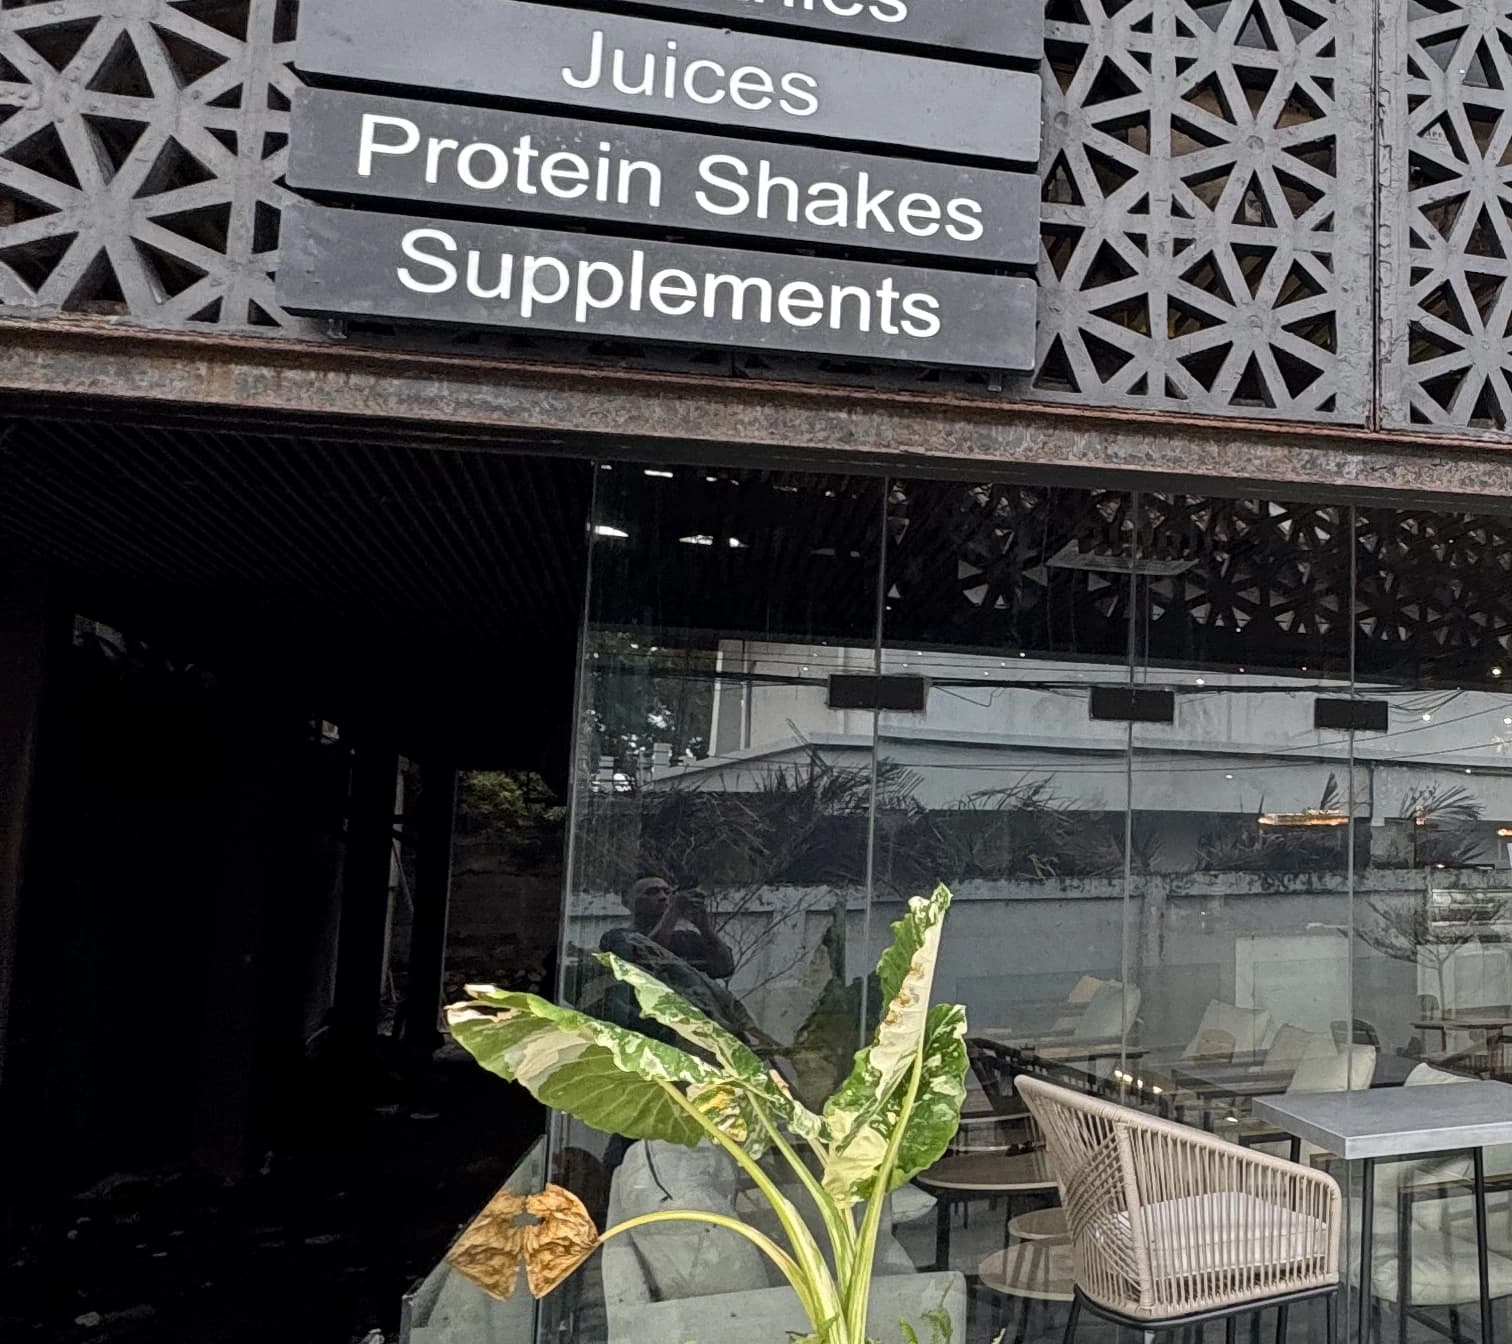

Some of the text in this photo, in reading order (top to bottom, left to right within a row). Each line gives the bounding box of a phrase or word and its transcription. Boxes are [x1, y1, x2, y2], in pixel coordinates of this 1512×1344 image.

[561, 30, 819, 116] Juices
[357, 113, 984, 242] Protein Shakes
[396, 228, 941, 338] Supplements
